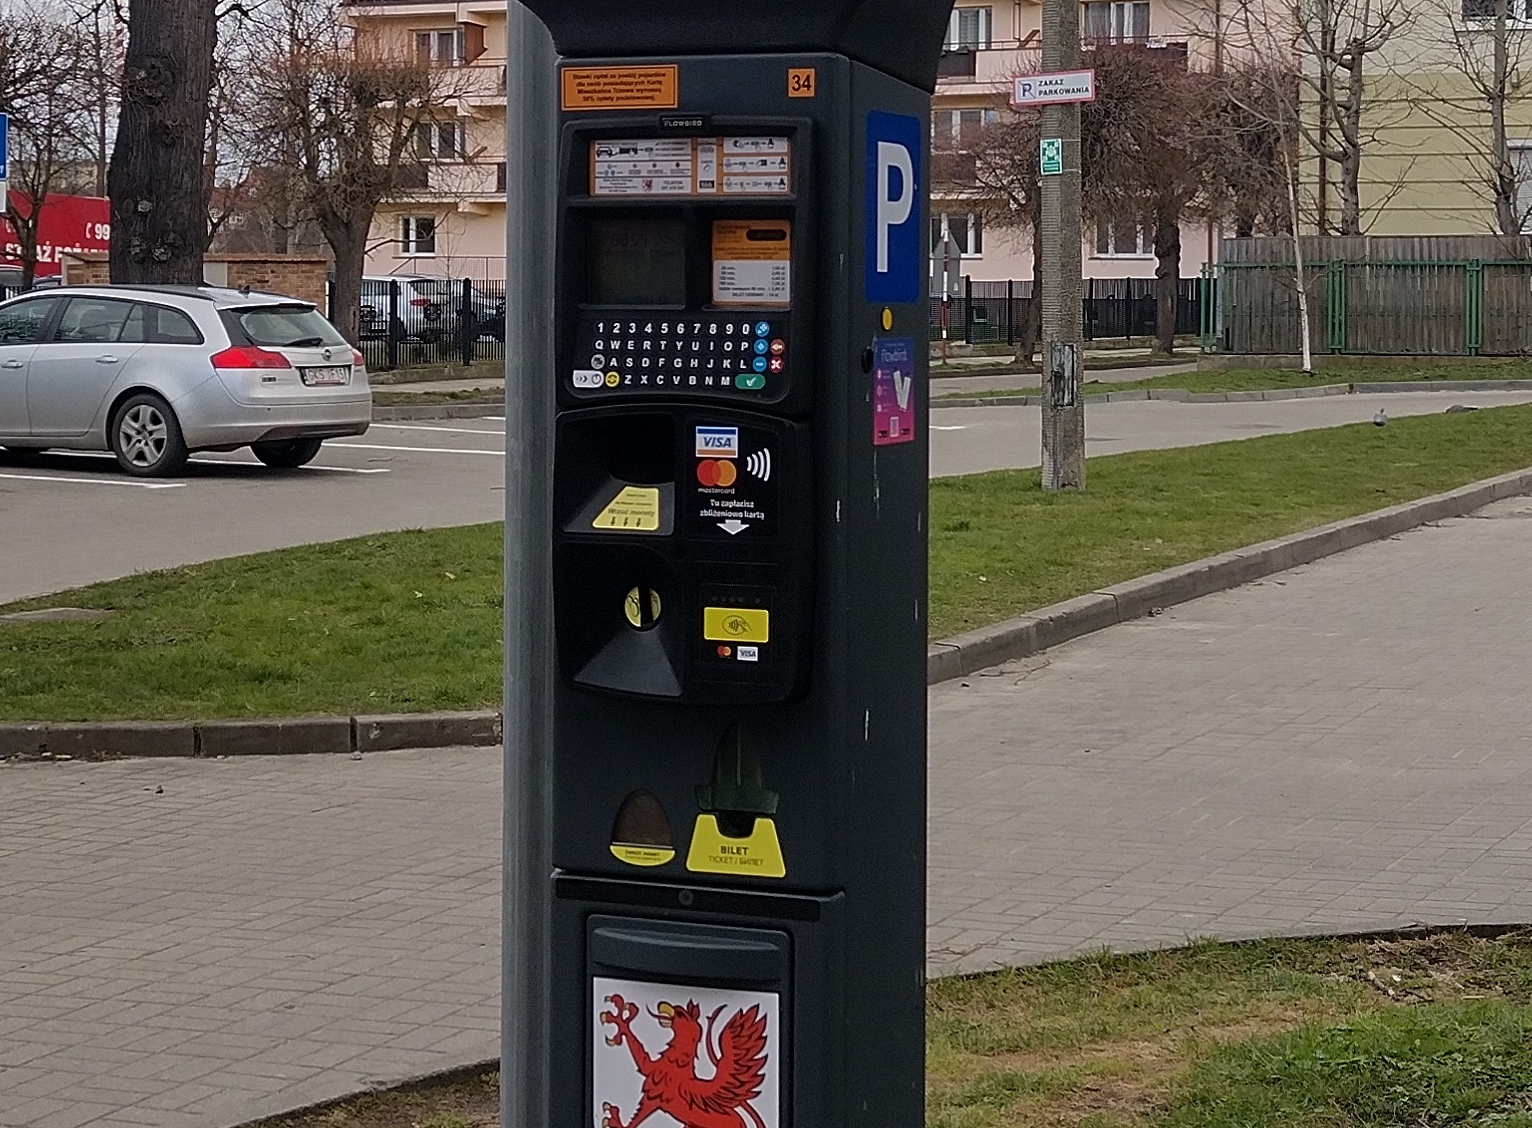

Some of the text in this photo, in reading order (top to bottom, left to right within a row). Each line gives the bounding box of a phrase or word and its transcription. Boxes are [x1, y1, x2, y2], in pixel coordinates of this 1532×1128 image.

[791, 74, 812, 92] 34
[1038, 79, 1064, 87] ZAKAZ
[1038, 86, 1089, 97] PARKOWANIA
[877, 141, 914, 273] P
[6, 241, 52, 263] STAŻ
[597, 322, 603, 332] 1
[612, 322, 620, 333] 2
[628, 322, 636, 333] 3
[644, 322, 652, 333] 4
[660, 322, 668, 333] 5
[676, 322, 684, 334] 6
[693, 323, 700, 333] 7
[709, 323, 716, 334] 8
[725, 323, 733, 334] 9
[595, 339, 603, 349] Q
[610, 340, 620, 349] W
[627, 340, 634, 349] E
[642, 340, 651, 349] R
[659, 340, 666, 350] T
[675, 340, 683, 350] Y
[691, 341, 699, 350] U
[740, 341, 748, 351] P
[703, 436, 732, 448] VISA
[739, 650, 756, 658] VISA
[720, 845, 749, 856] BILET
